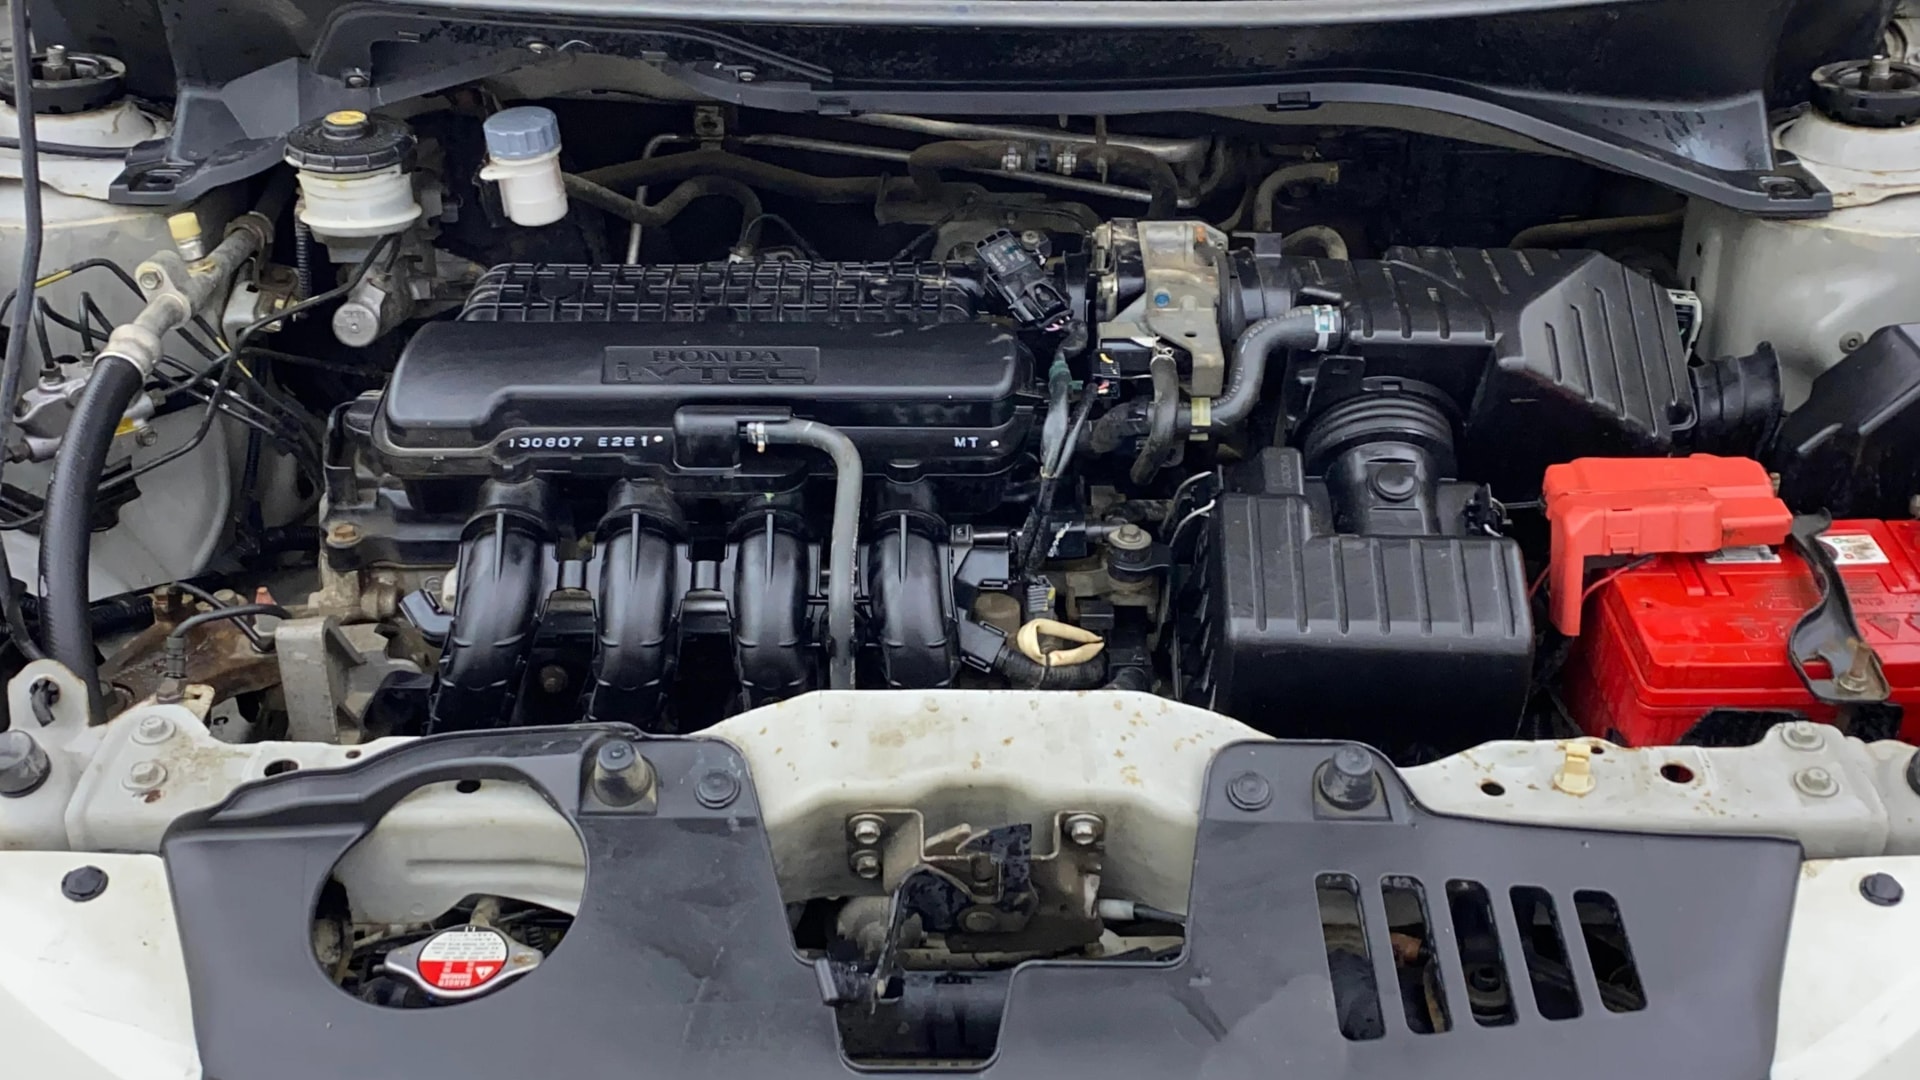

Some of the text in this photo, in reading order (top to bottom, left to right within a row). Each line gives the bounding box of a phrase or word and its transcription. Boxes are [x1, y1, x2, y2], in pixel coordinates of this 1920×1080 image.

[649, 350, 792, 365] HONDA
[508, 435, 648, 448] 130807 E2E1
[953, 436, 979, 448] MT
